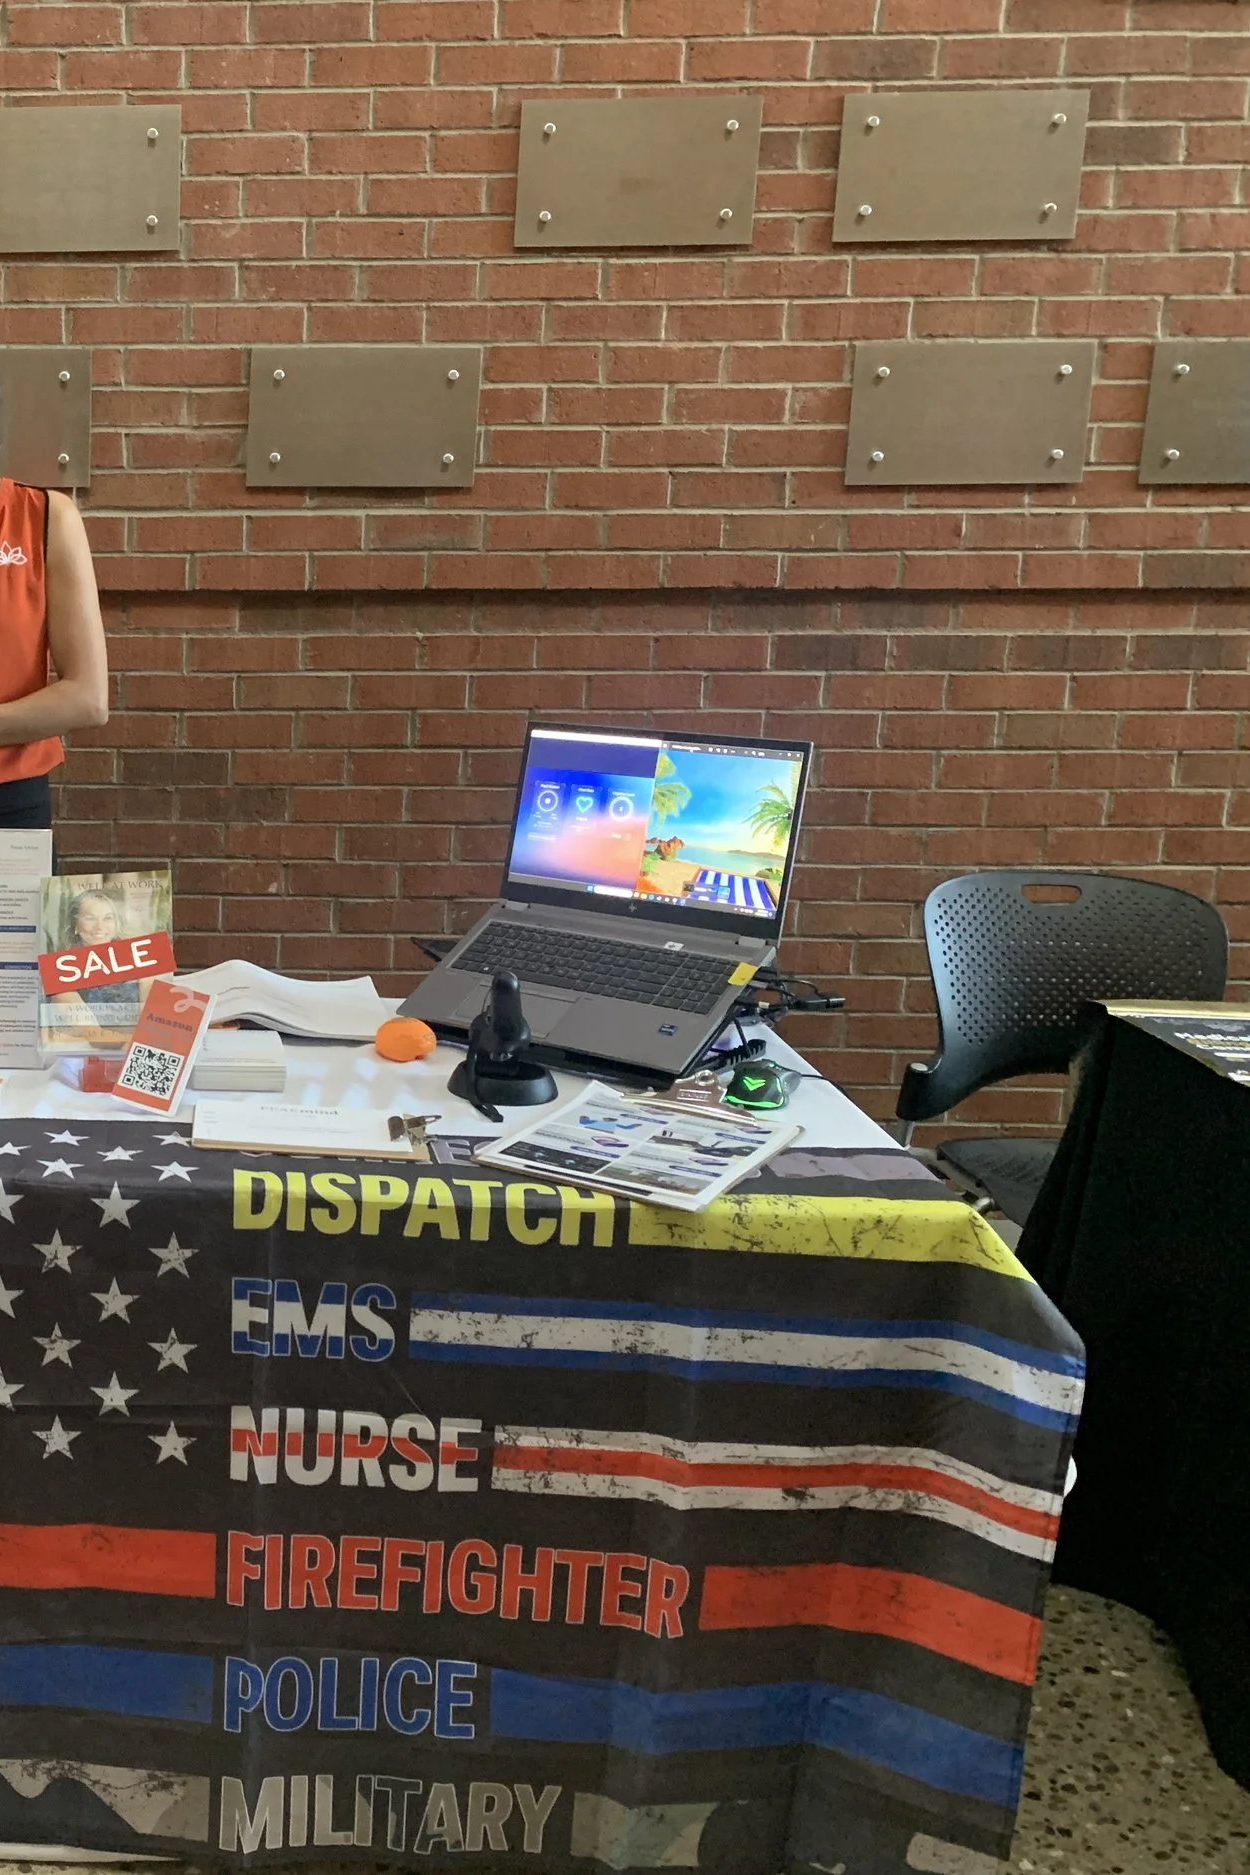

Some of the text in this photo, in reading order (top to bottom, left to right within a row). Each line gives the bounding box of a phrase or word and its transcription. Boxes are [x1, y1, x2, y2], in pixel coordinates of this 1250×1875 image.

[128, 879, 163, 890] WORK
[56, 939, 157, 983] SALE
[146, 1013, 193, 1032] Amazon
[233, 1169, 615, 1247] DISPATCH
[230, 1276, 397, 1363] EMS
[229, 1404, 483, 1493] NURSE
[226, 1530, 690, 1640] FIREFIGHTER
[223, 1656, 477, 1740] POLICE
[219, 1774, 562, 1856] MILITARY
